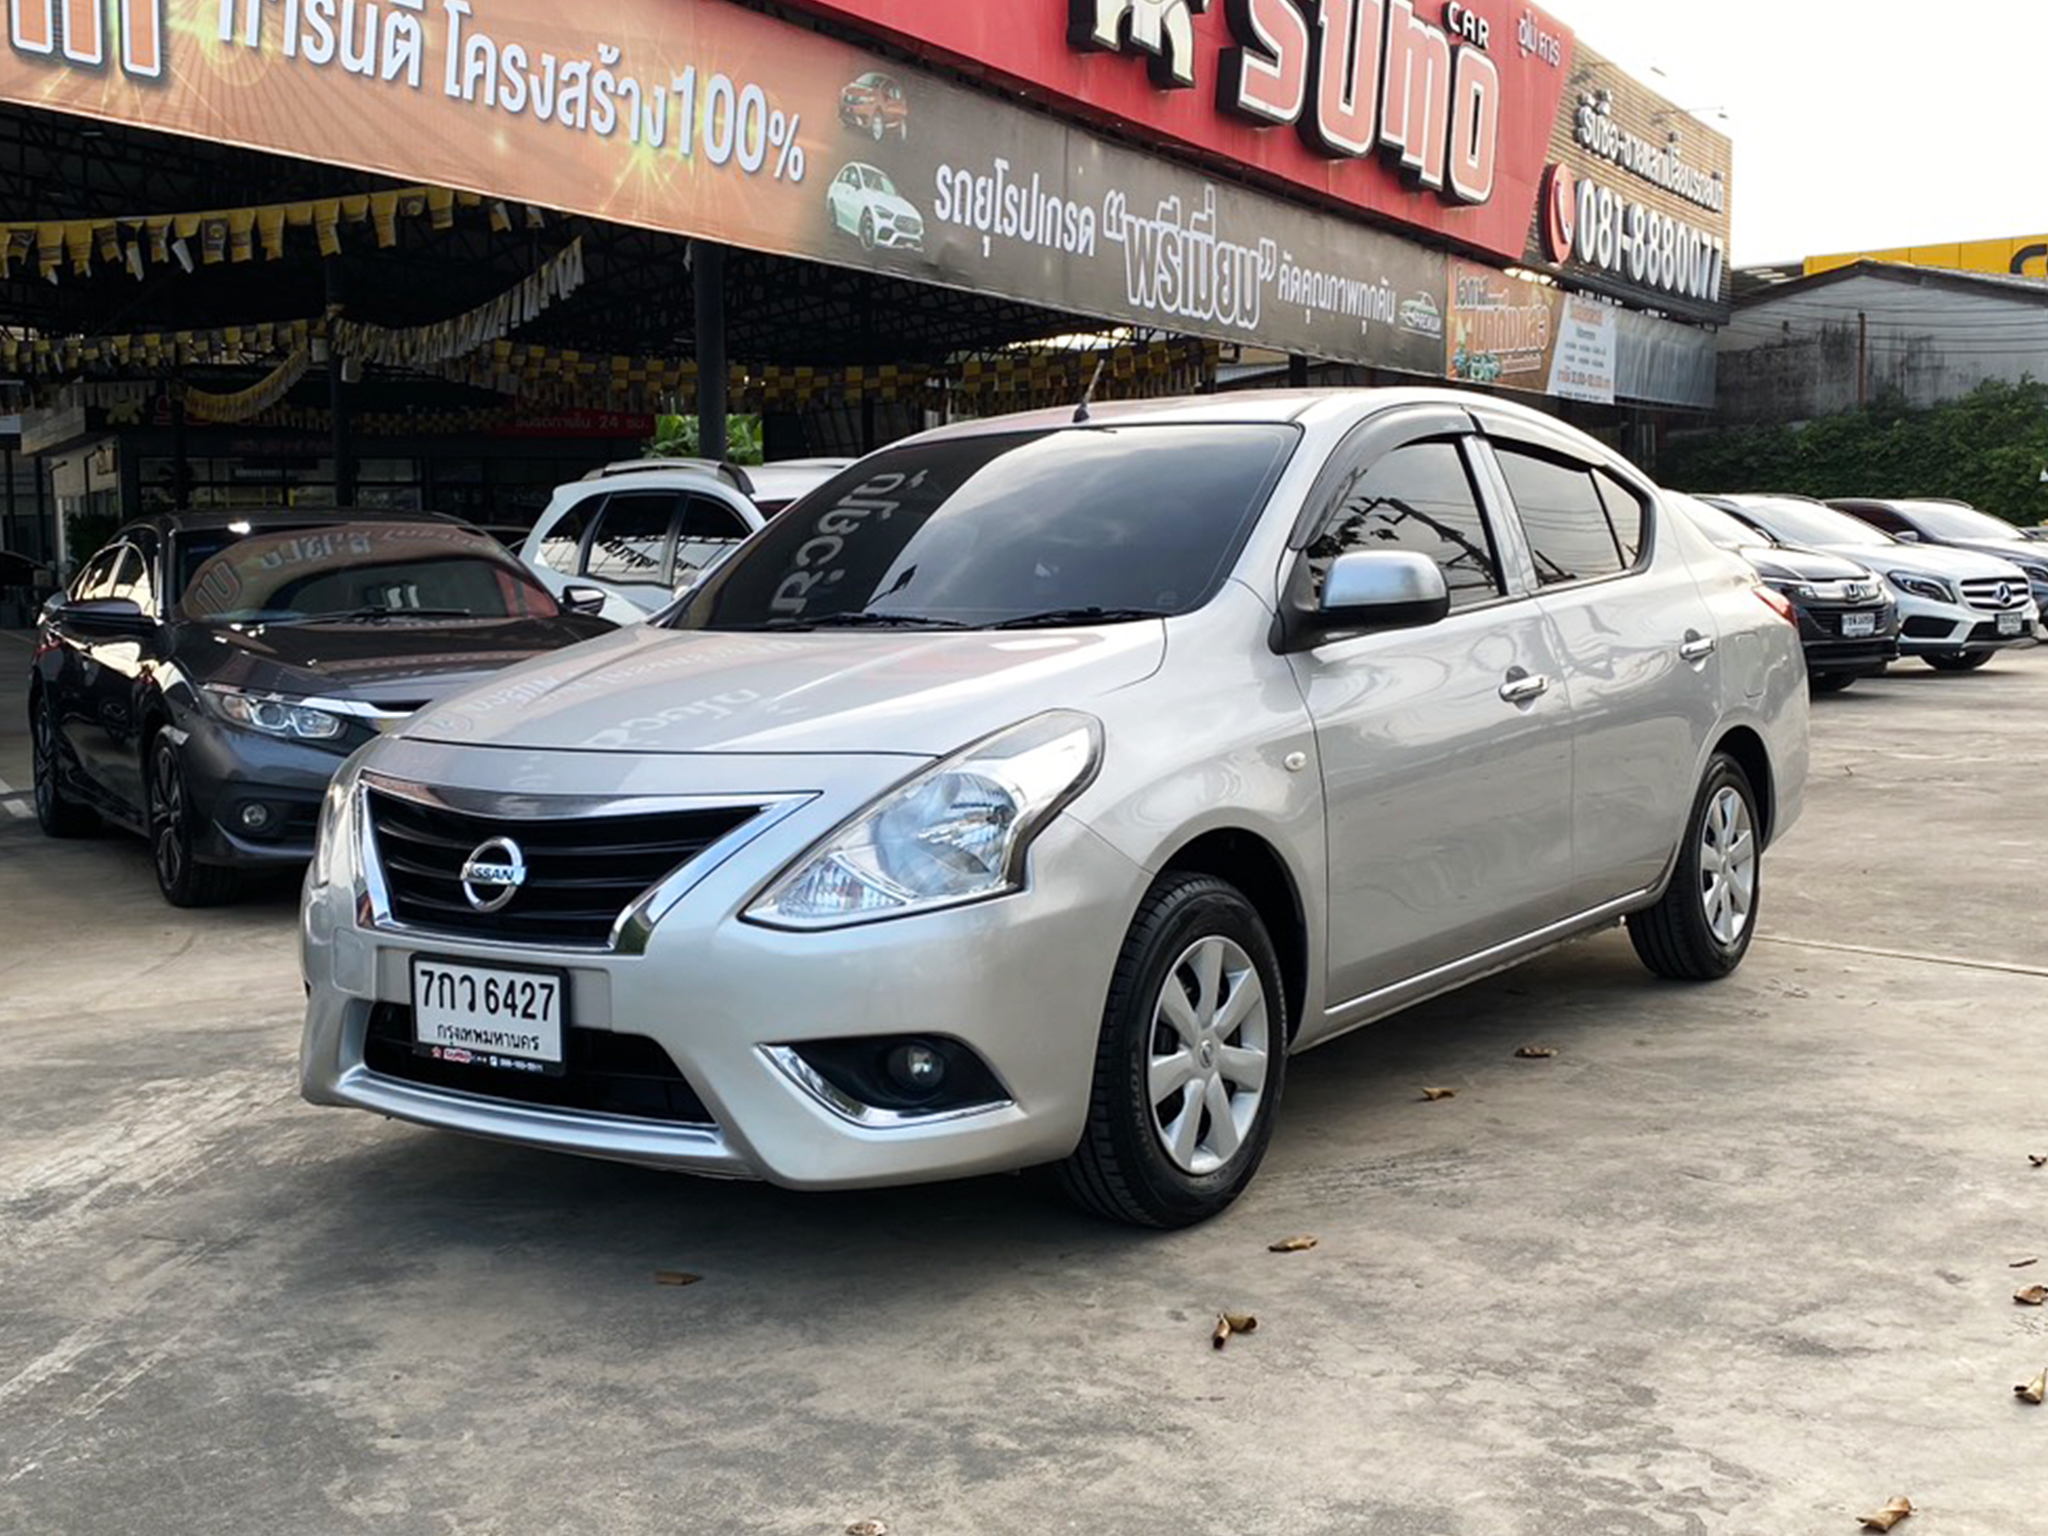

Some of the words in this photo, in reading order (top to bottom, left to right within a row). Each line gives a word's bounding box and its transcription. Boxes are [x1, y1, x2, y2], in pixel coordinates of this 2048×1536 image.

[1447, 0, 1489, 50] CAR
[935, 158, 1097, 258] รถยุโรปเกรด
[1578, 178, 1725, 303] 081-8880077
[420, 969, 476, 1013] 7กว
[485, 977, 555, 1022] 6427
[437, 1024, 540, 1051] กรุงเทพมหานคร
